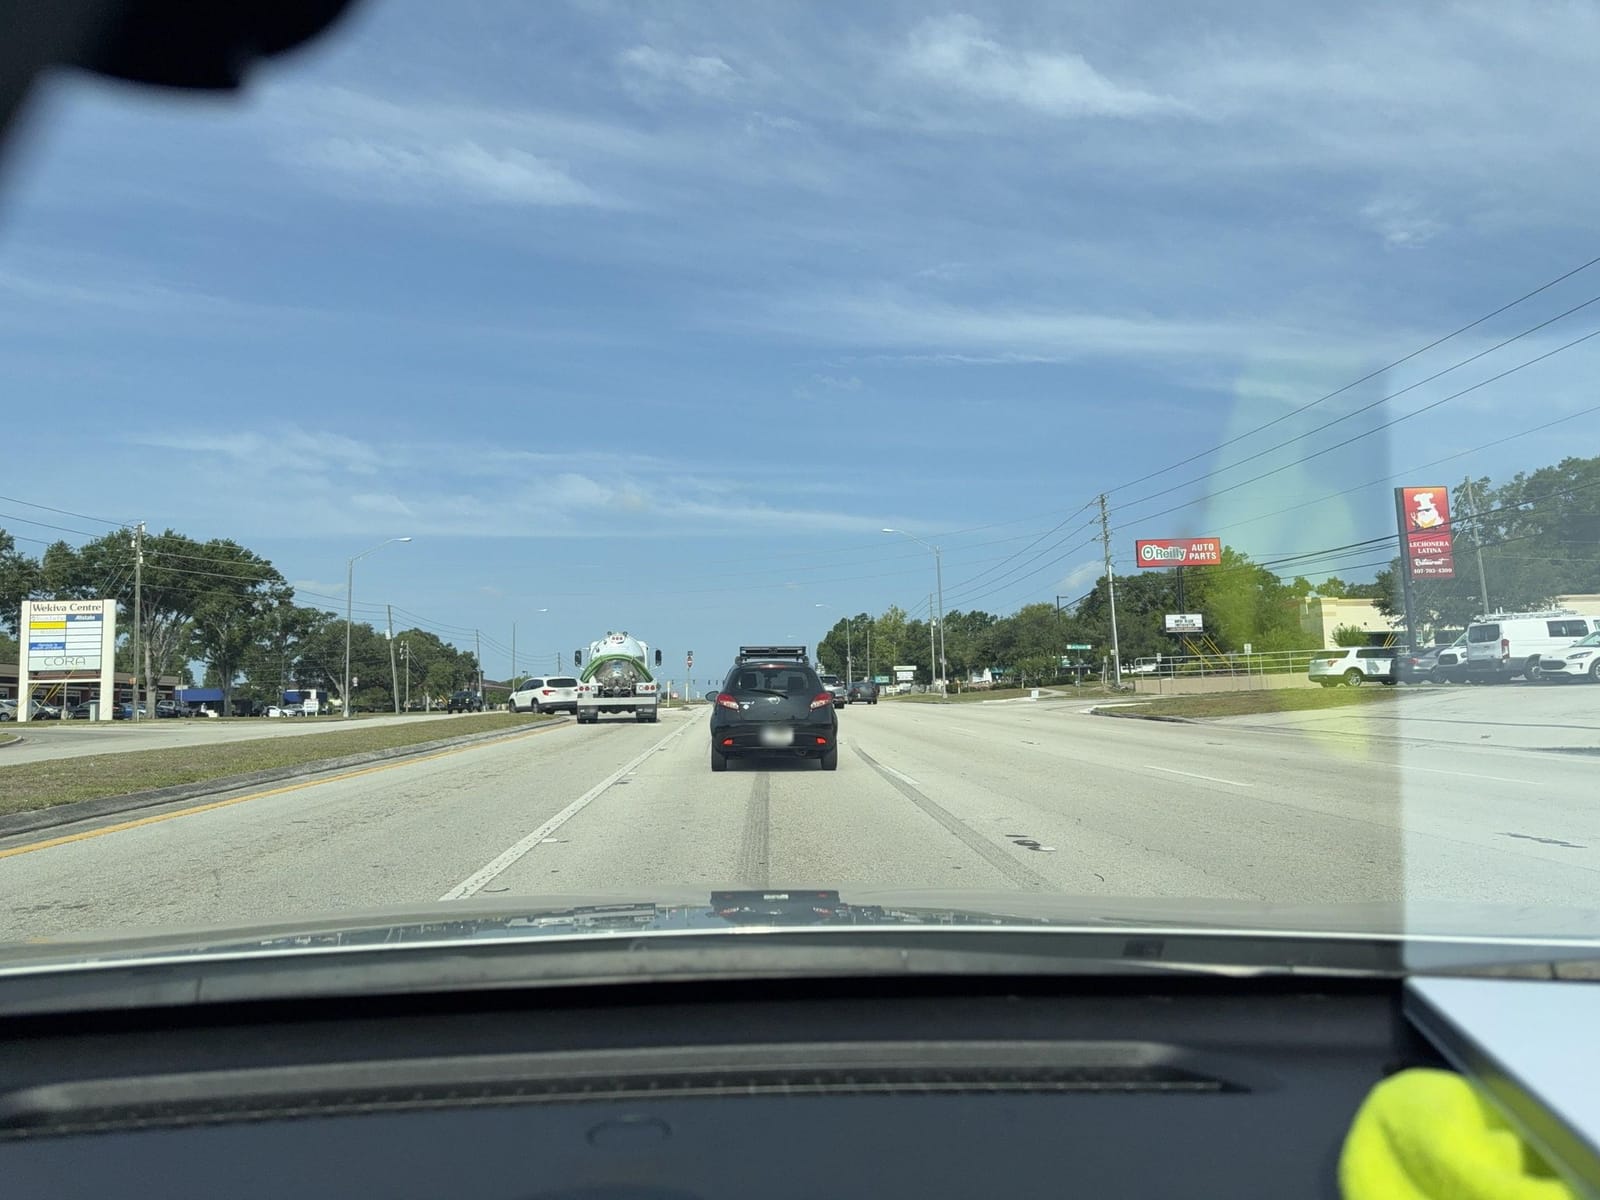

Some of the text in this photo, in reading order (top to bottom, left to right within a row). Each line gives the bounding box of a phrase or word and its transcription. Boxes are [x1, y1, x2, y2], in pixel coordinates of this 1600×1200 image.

[1142, 543, 1214, 561] O'Reilly AUTO
[1189, 552, 1217, 560] PARTS
[32, 603, 101, 612] Wekiva Centre
[43, 656, 86, 667] CORA
